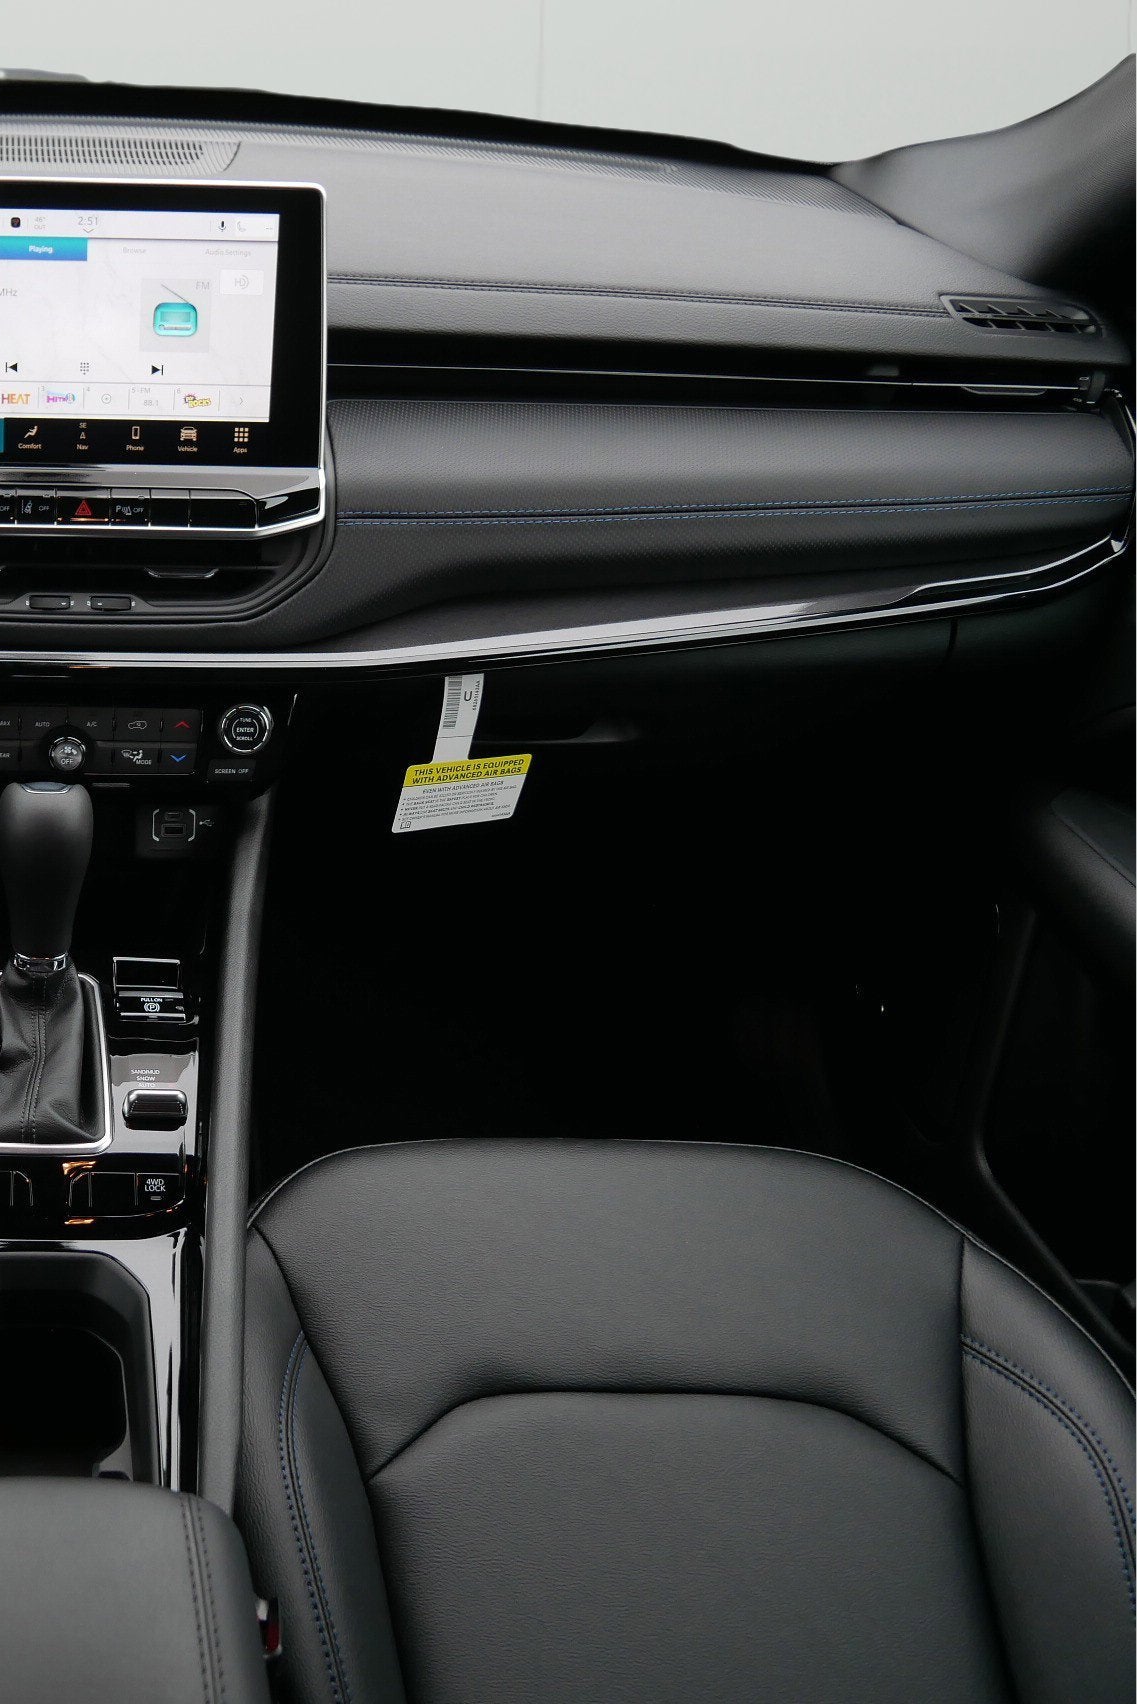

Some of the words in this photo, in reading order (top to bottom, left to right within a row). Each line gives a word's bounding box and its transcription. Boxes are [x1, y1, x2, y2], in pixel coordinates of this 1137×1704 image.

[78, 216, 99, 226] 2:51
[28, 245, 53, 254] Playing
[225, 249, 252, 258] Settings
[196, 281, 210, 290] FM
[1, 393, 30, 405] HEAT
[18, 442, 42, 450] Comfort
[464, 690, 473, 702] U
[435, 764, 471, 774] VEHICLE
[482, 759, 525, 769] EQUIPPED
[412, 776, 435, 784] WITH
[436, 771, 483, 782] ADVANCED
[500, 766, 522, 775] BAGS
[144, 1184, 166, 1192] LOCK
